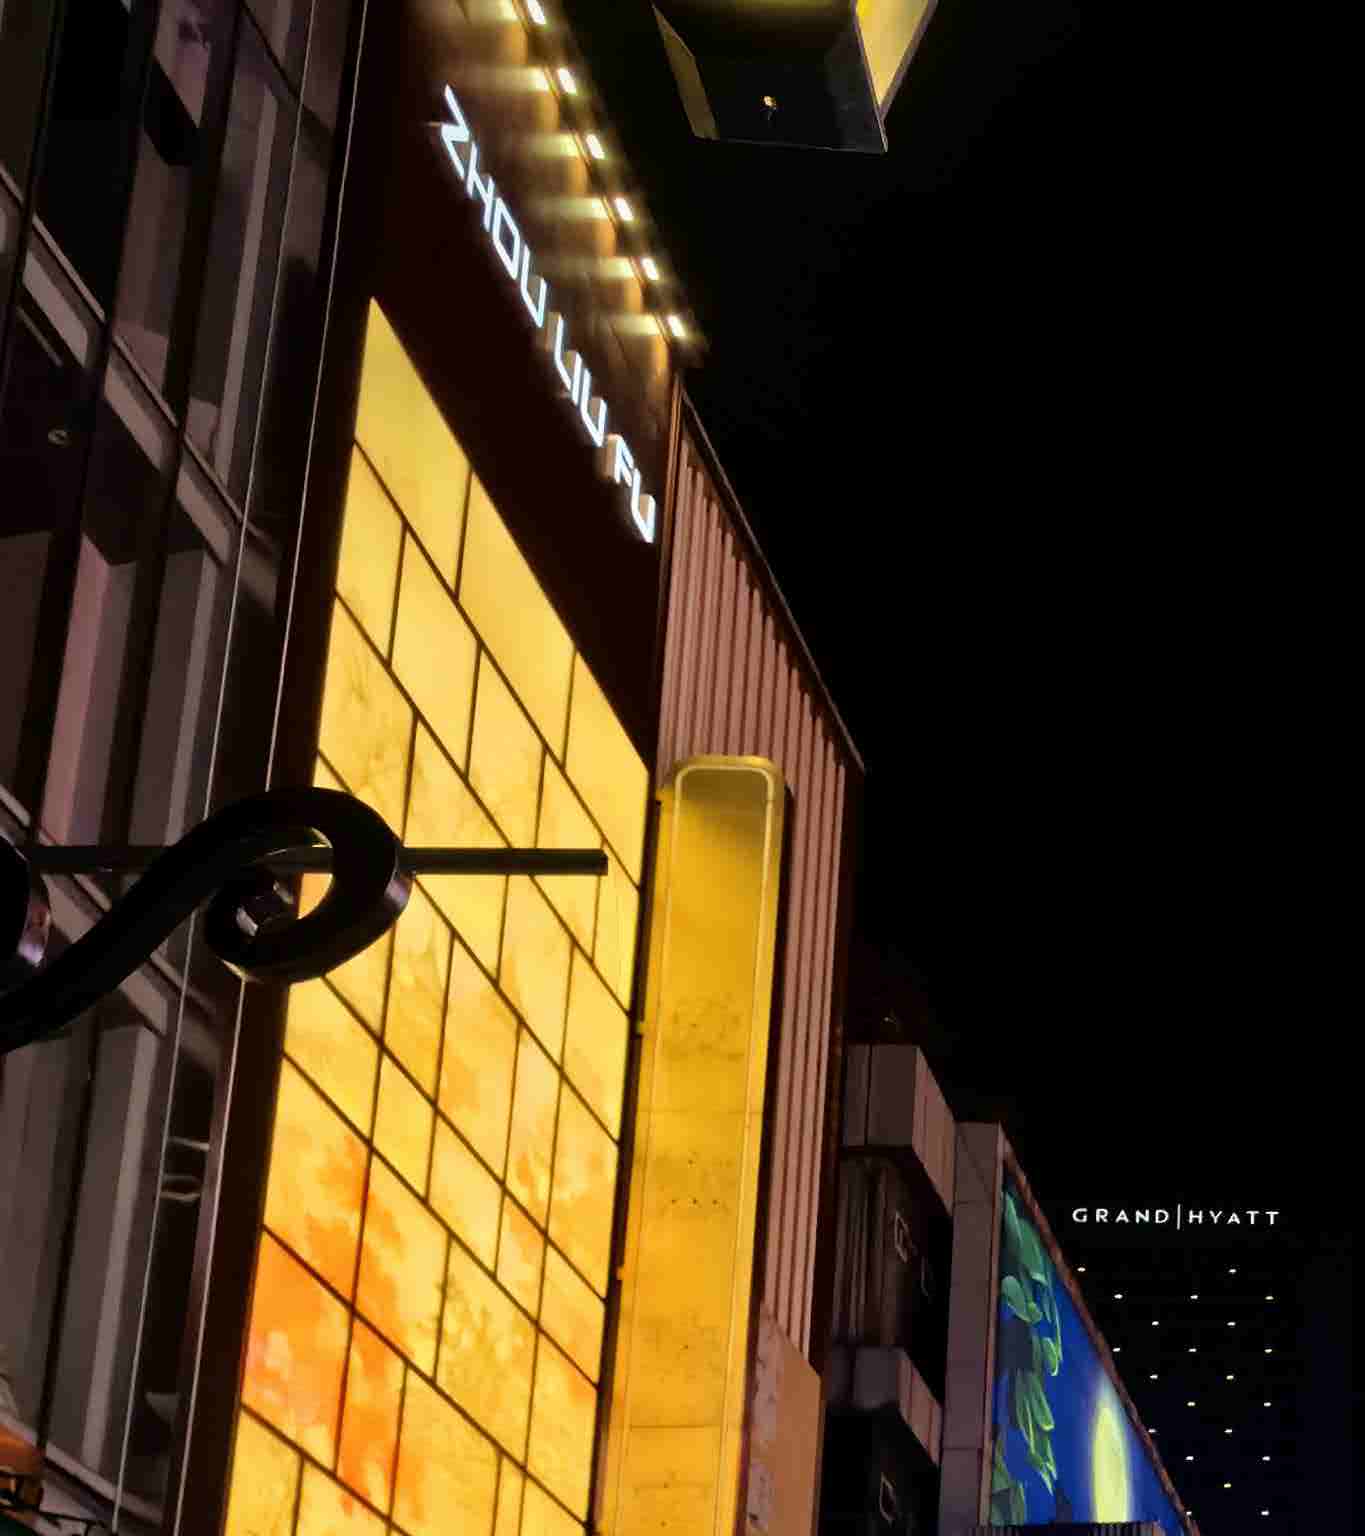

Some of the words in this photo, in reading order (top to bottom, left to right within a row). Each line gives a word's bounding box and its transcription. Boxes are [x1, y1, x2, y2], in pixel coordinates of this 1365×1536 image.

[438, 84, 546, 328] ZHOU
[552, 316, 606, 447] LIU
[611, 434, 657, 543] FU
[1071, 1207, 1170, 1224] GRAND
[1187, 1209, 1280, 1226] HYATT
